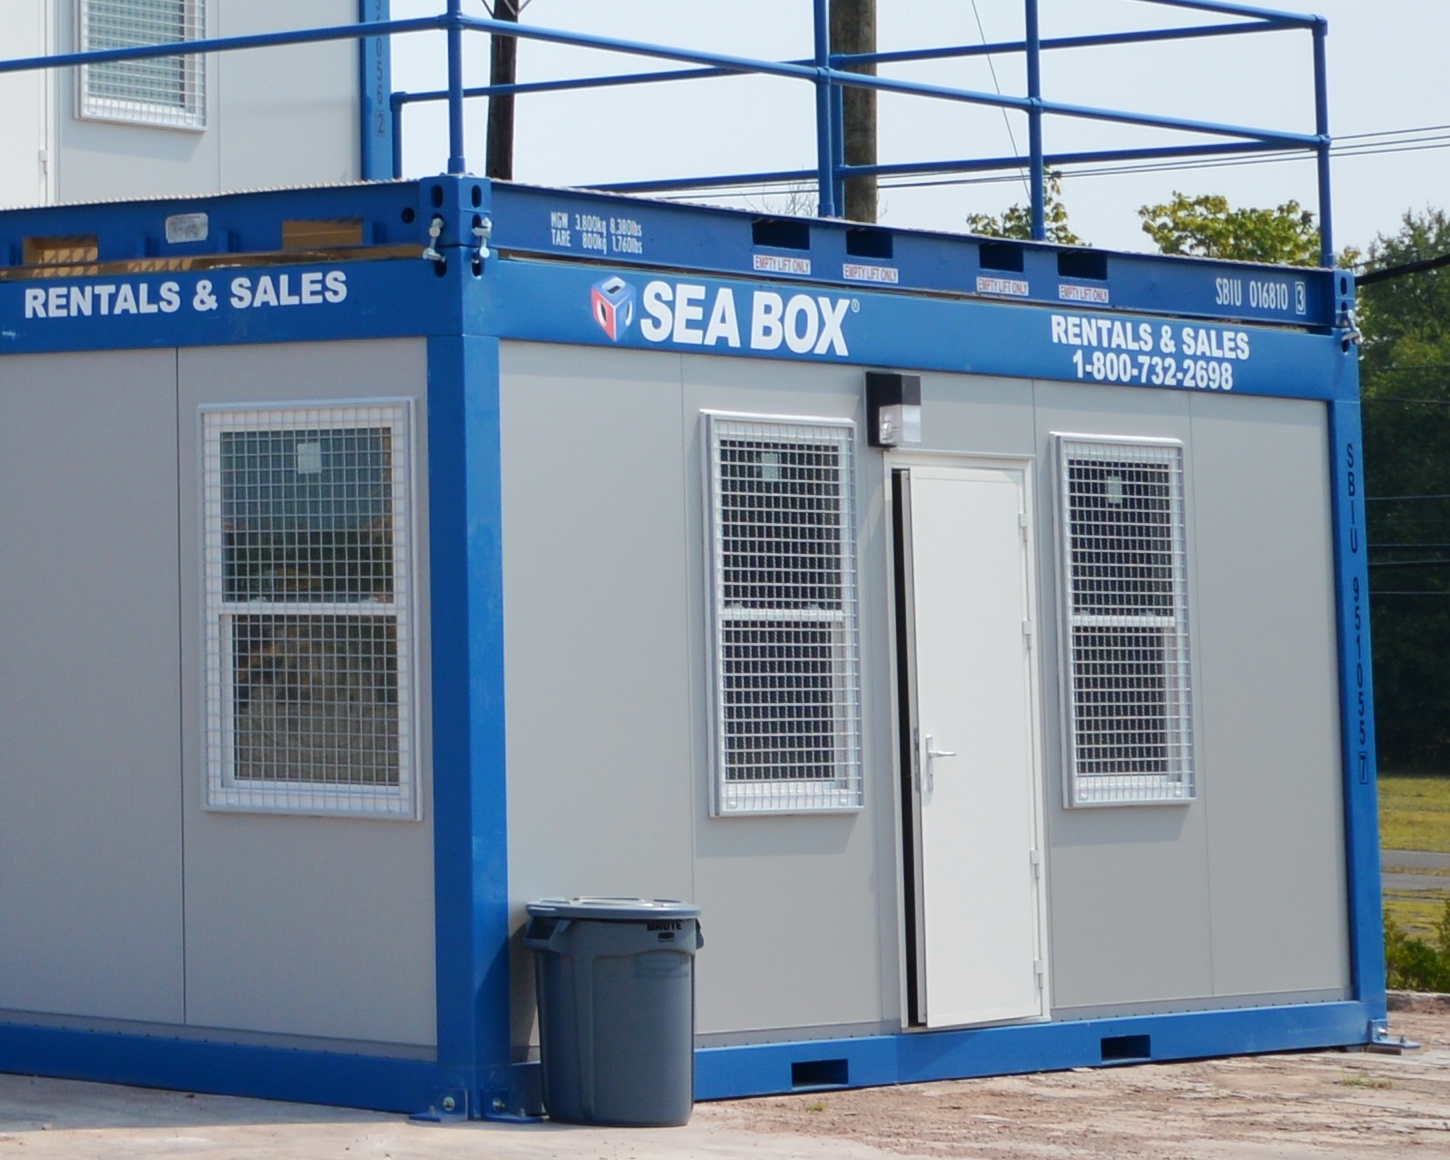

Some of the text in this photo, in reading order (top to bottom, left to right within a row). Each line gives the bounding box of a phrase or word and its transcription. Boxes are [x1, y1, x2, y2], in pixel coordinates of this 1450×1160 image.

[551, 229, 571, 247] TARE
[755, 255, 809, 273] EMPTY LIFT ONLY
[845, 265, 897, 282] EMPTY LIFT ONLY
[24, 270, 348, 319] RENTALS & SALES
[979, 278, 1027, 294] EMPTY LIFT ONLY
[1060, 286, 1107, 302] EMPTY LIFT ONLY
[1215, 277, 1305, 313] SBIU 016810 3
[640, 280, 850, 357] SEA BOX
[1051, 315, 1250, 360] RENTALS & SALES
[1072, 349, 1234, 390] 1-800-732-2698
[1346, 443, 1358, 554] SBIU
[1353, 576, 1365, 745] 951055
